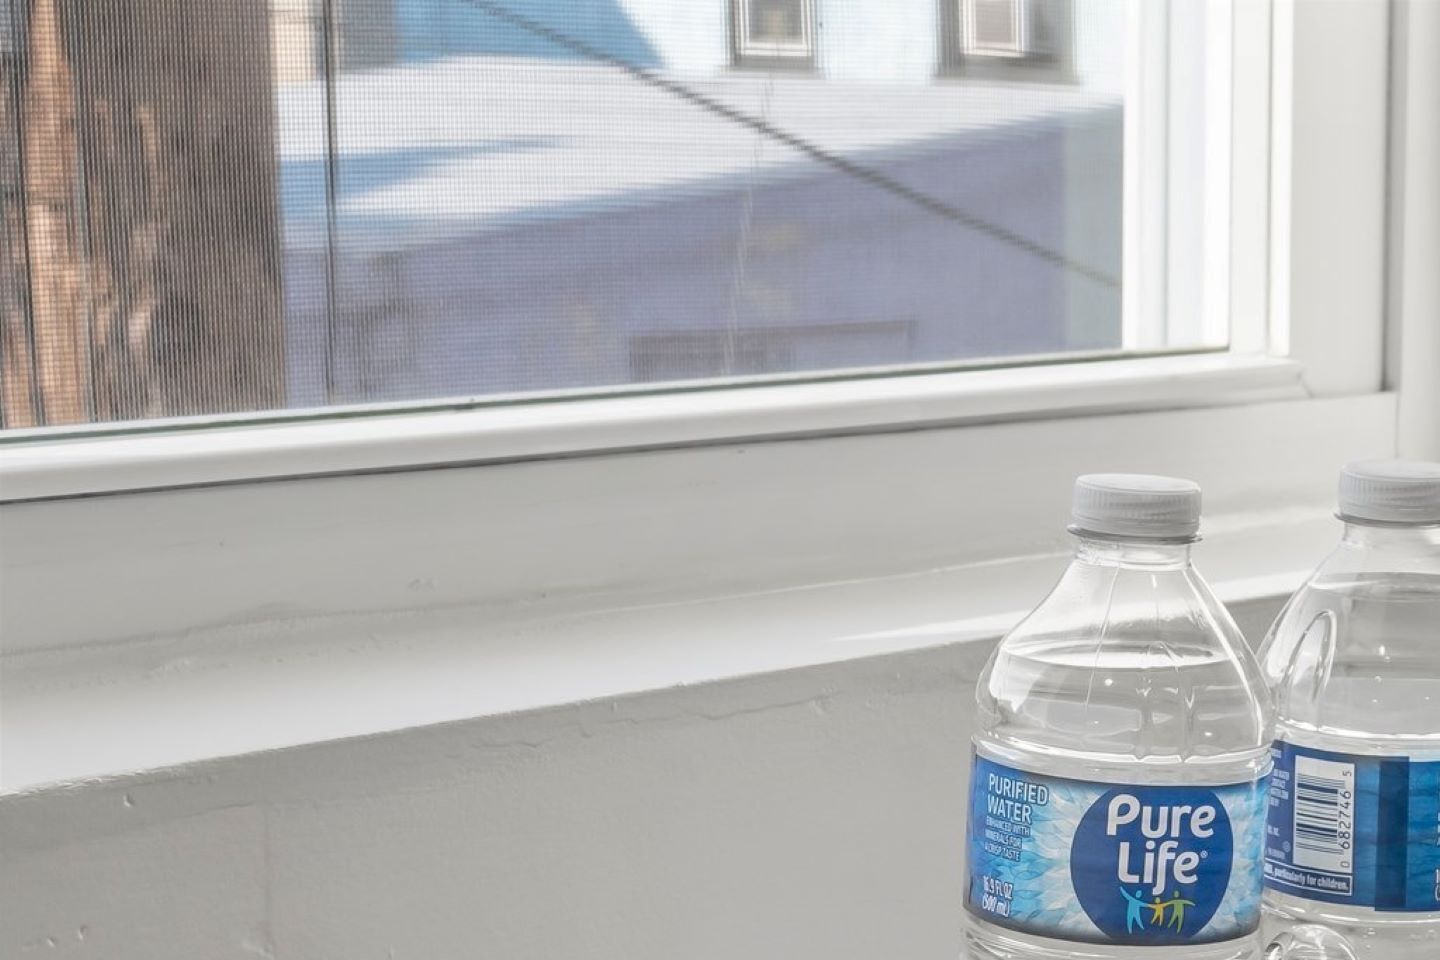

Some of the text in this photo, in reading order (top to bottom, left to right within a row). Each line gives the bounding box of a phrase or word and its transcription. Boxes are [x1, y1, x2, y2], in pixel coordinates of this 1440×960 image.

[989, 772, 1049, 805] PURIFIED
[987, 794, 1032, 825] WATER
[1107, 794, 1216, 838] Pure
[1337, 790, 1352, 850] 682746
[1004, 882, 1013, 900] OZ
